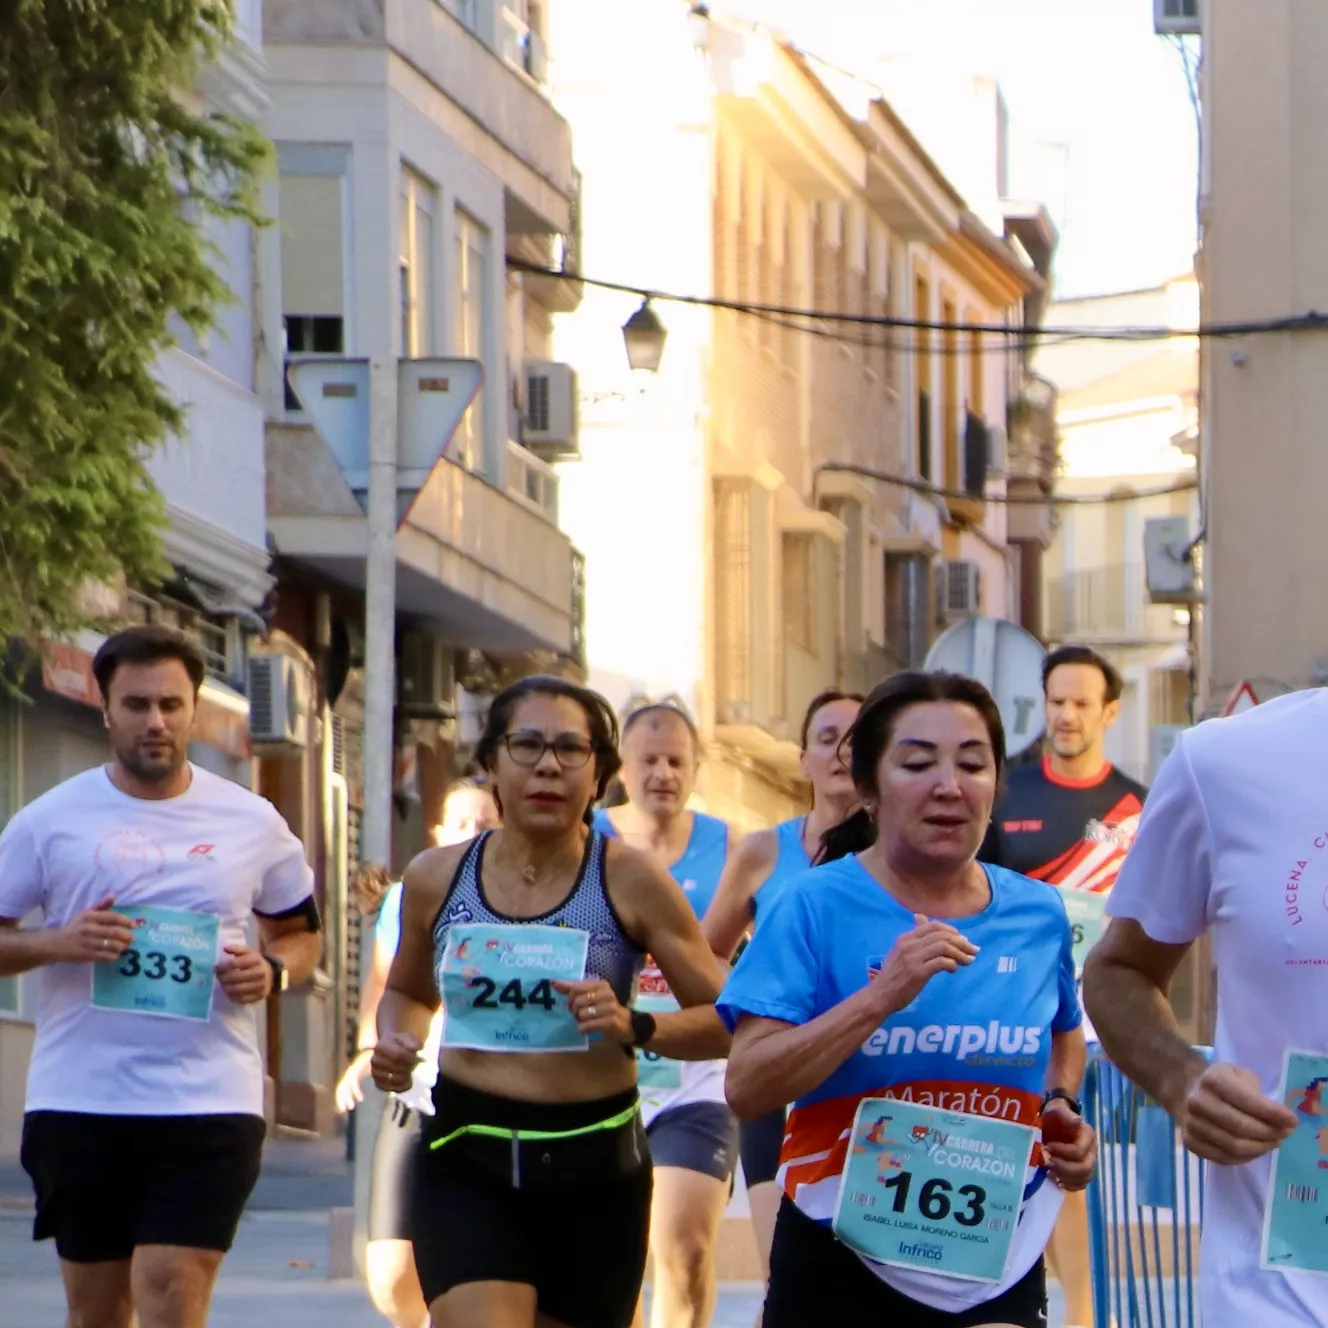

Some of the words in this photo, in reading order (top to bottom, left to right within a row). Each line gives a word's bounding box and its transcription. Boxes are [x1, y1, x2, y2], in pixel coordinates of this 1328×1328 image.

[1285, 859, 1308, 926] LUCENA
[119, 949, 192, 983] 333
[471, 977, 556, 1010] 244
[861, 1020, 1042, 1060] enerplus
[933, 1149, 1016, 1178] CORAZÓN
[885, 1171, 986, 1227] 163
[863, 1213, 893, 1226] ISABEL
[894, 1219, 919, 1231] LUISA
[921, 1225, 958, 1239] MORENO
[959, 1232, 989, 1244] GARCIA
[899, 1241, 943, 1261] Infrico
